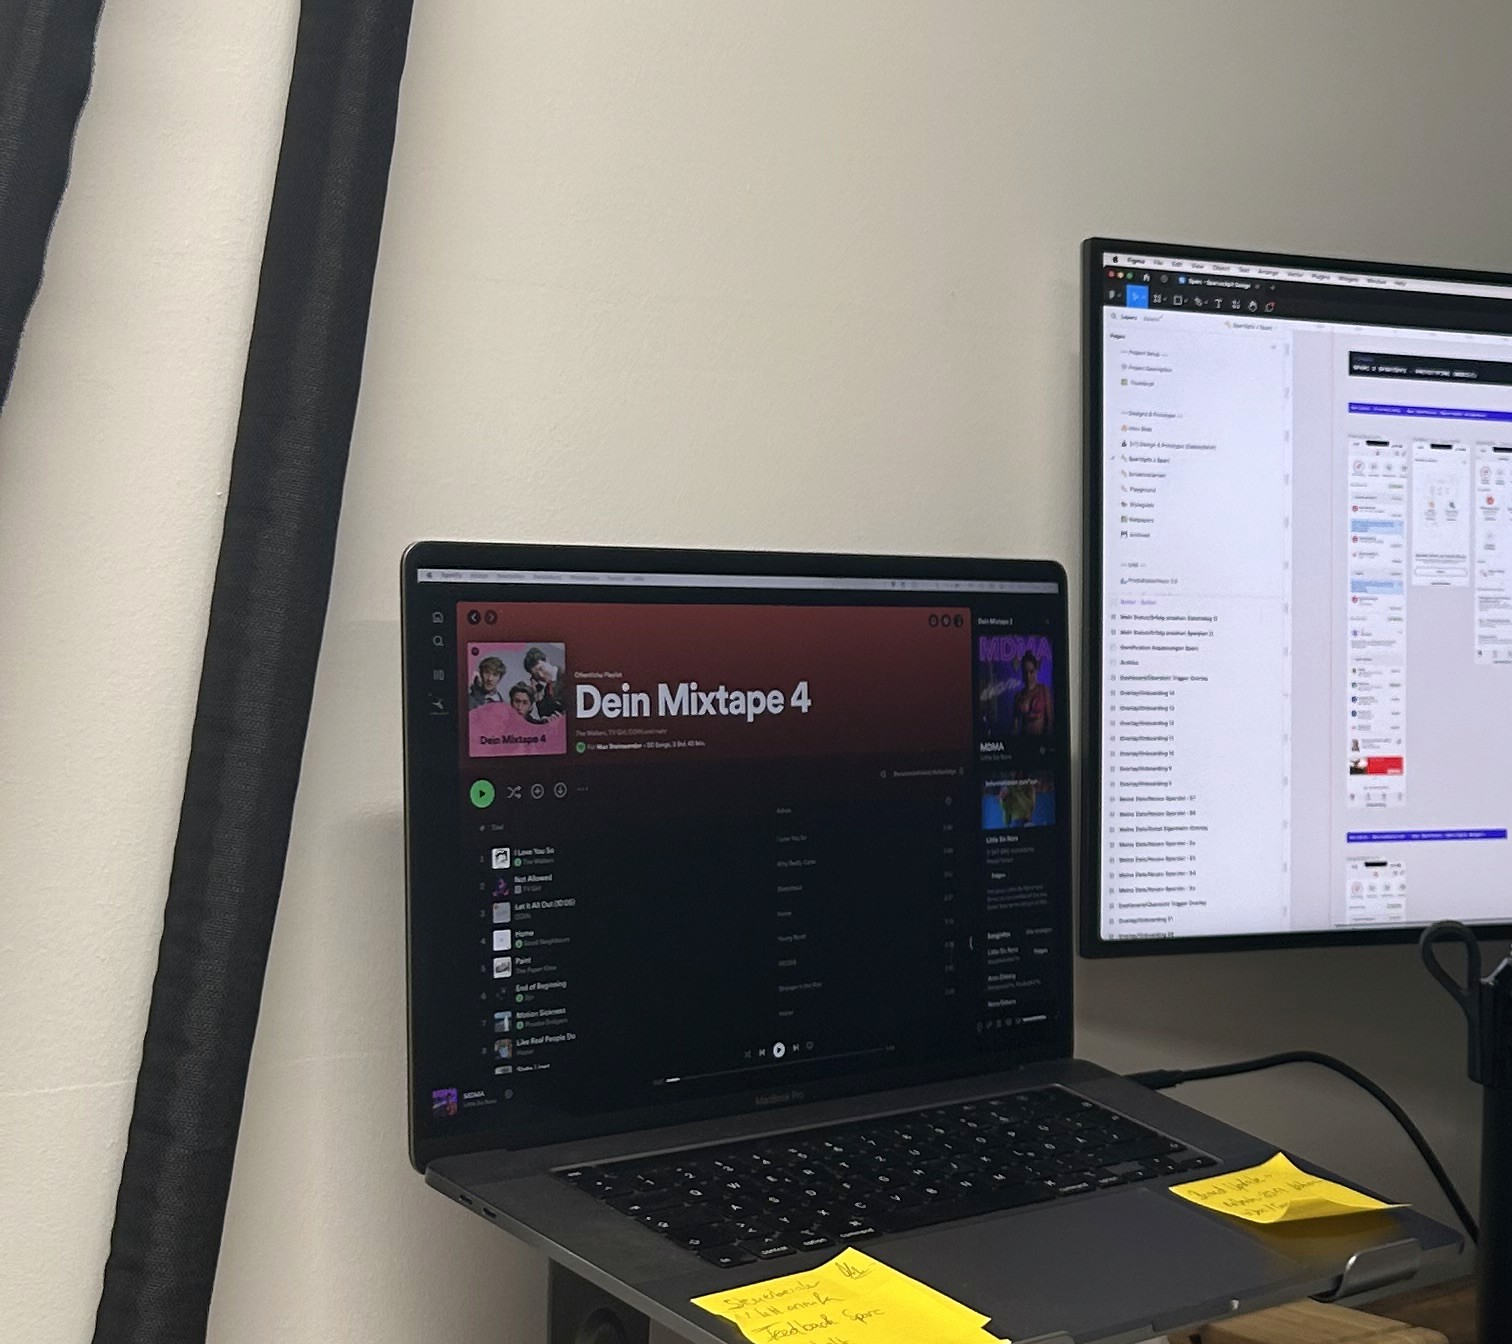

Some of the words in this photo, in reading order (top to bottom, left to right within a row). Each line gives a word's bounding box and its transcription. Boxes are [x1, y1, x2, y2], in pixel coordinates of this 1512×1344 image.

[979, 636, 1052, 662] MDMA
[576, 683, 650, 719] Dein
[658, 681, 784, 723] Mixtape
[790, 680, 812, 713] 4
[480, 734, 500, 745] Dein
[502, 734, 539, 747] Mixtape
[539, 734, 547, 744] 4
[979, 741, 1005, 752] MDMA
[527, 873, 553, 882] Allowed
[515, 930, 535, 938] Home
[515, 957, 532, 965] Paint
[537, 980, 568, 991] Beginning
[516, 1010, 539, 1019] Motion
[539, 1007, 566, 1017] Sickness
[545, 1034, 566, 1044] People
[839, 1227, 875, 1238] command
[802, 1237, 827, 1246] option
[761, 1245, 788, 1255] control
[752, 1313, 840, 1342] Feedback
